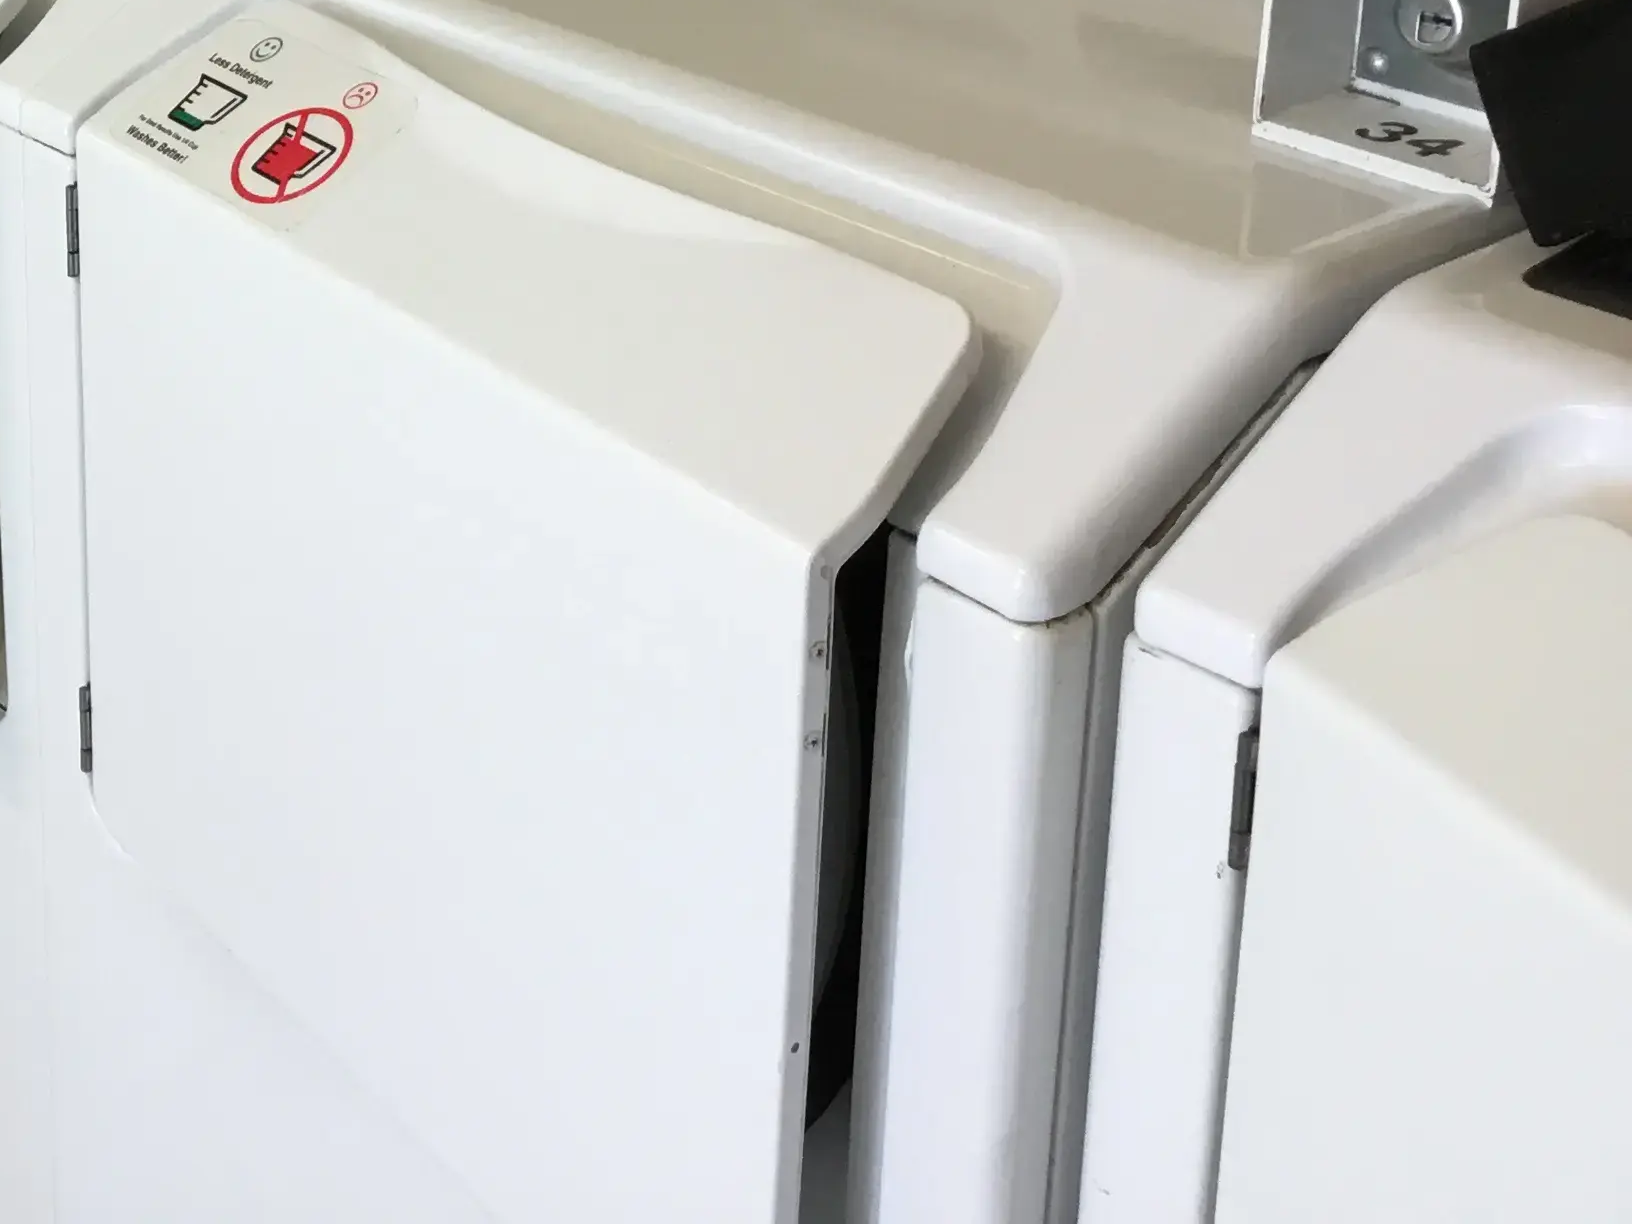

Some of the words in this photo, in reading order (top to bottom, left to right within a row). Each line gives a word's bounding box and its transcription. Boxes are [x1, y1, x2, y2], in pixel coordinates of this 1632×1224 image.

[208, 52, 231, 68] Less
[229, 62, 273, 89] Detergent
[126, 124, 158, 148] Washes
[156, 142, 189, 164] Better!
[1355, 120, 1464, 158] 34
